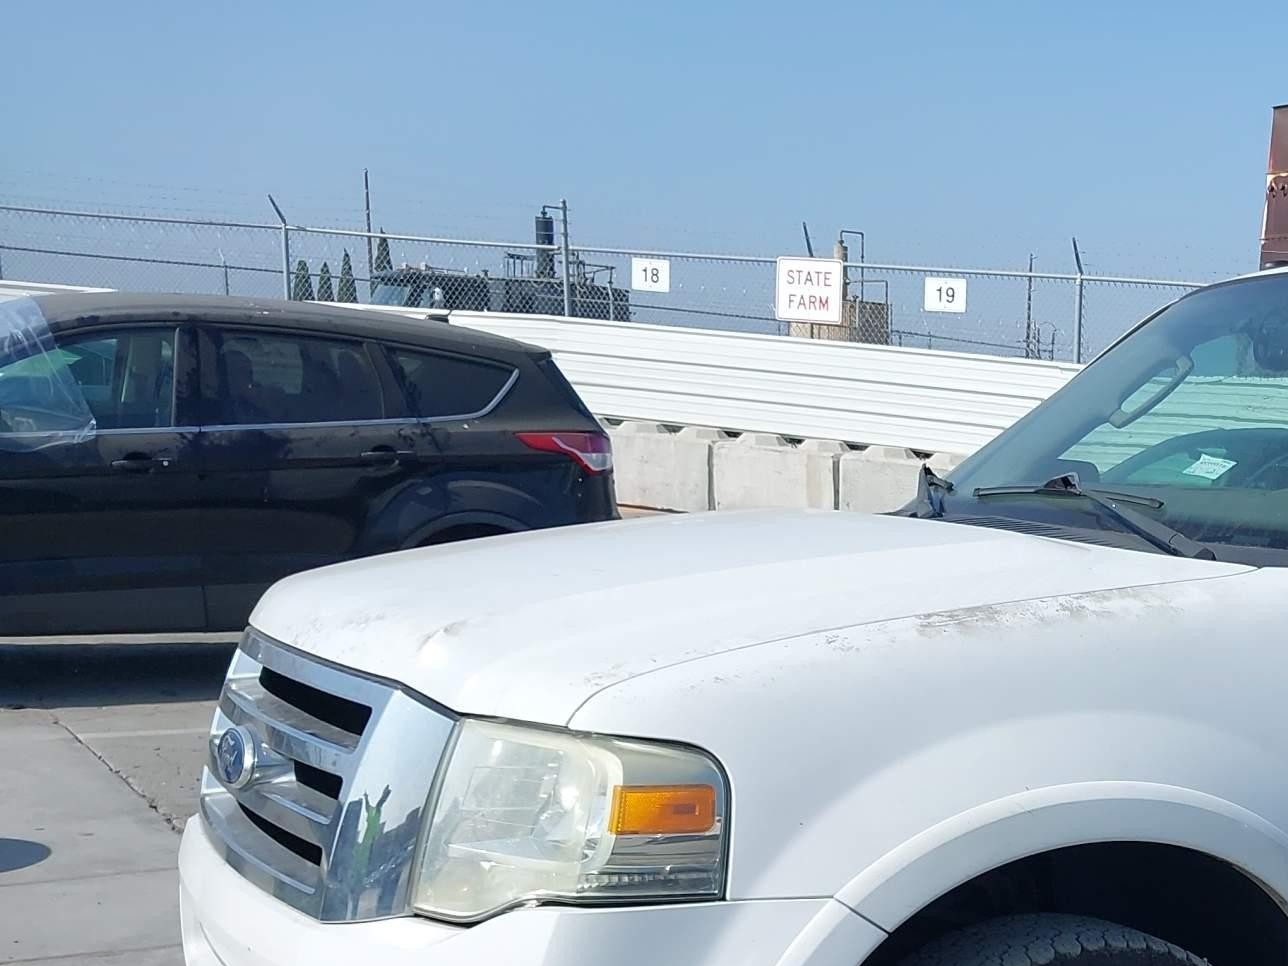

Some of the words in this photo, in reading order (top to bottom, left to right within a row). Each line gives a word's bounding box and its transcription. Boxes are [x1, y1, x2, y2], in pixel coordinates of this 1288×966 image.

[643, 267, 659, 283] 18
[787, 270, 832, 287] STATE
[788, 294, 829, 311] FARM
[936, 287, 955, 303] 19
